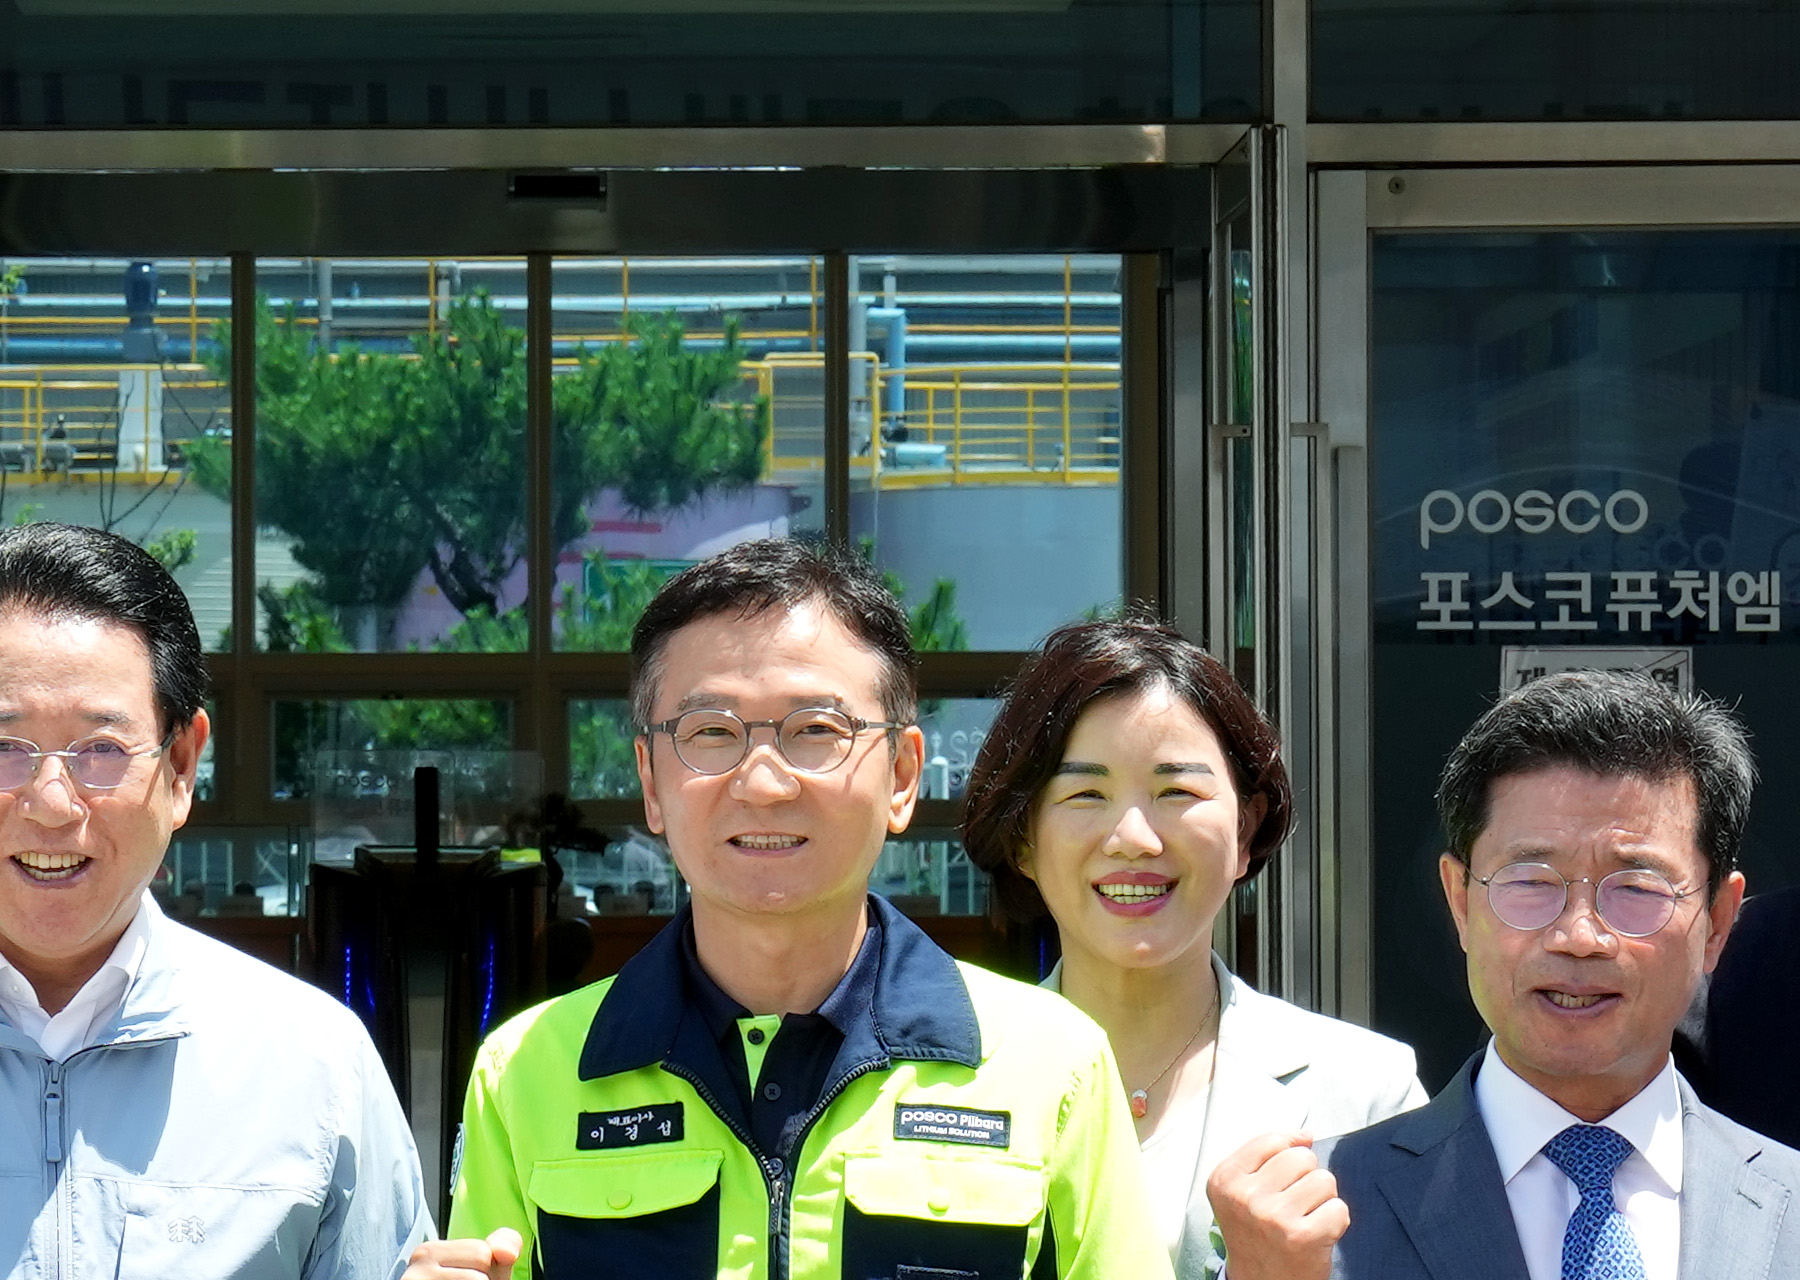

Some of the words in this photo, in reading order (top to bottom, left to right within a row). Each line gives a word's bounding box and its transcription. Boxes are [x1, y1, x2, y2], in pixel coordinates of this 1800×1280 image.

[1419, 489, 1649, 550] posco
[1416, 570, 1781, 632] 포스코퓨처엠
[901, 1110, 958, 1125] posco
[960, 1114, 1004, 1131] Pilbara
[913, 1124, 948, 1136] LITHIUM
[947, 1126, 990, 1139] SOLUTION
